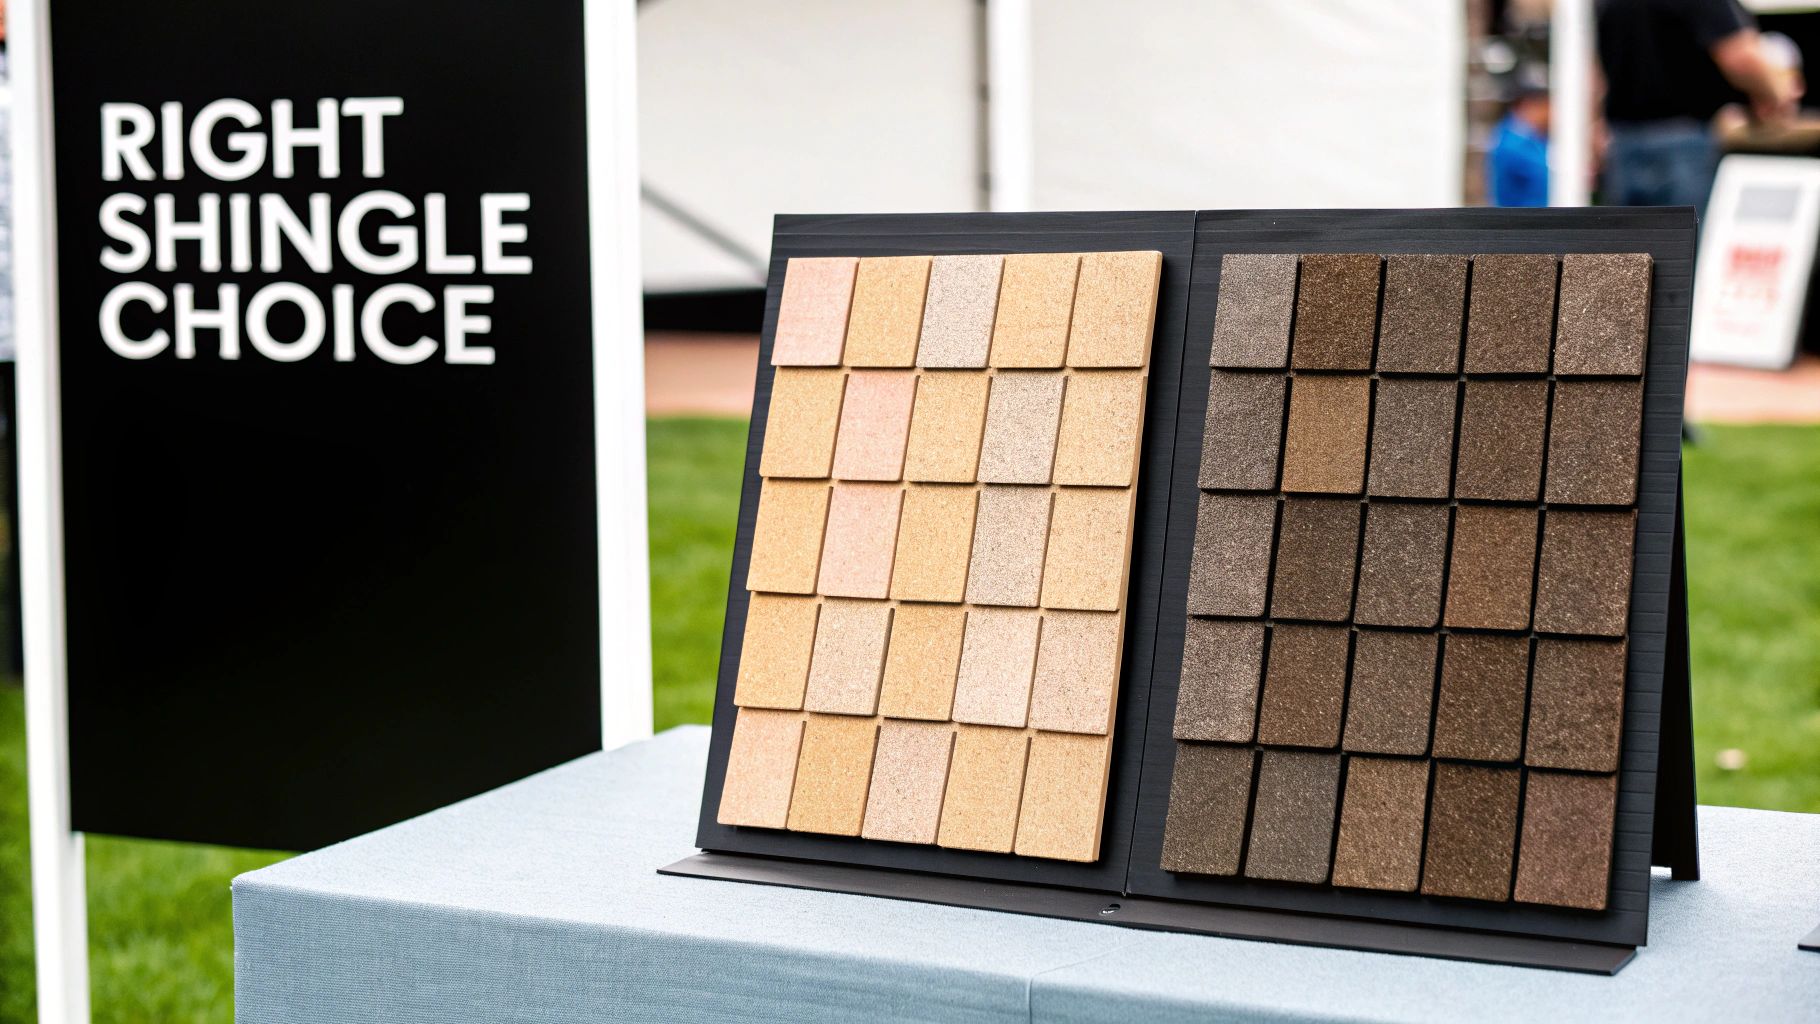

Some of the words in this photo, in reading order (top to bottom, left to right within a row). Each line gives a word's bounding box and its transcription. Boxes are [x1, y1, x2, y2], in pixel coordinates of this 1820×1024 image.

[100, 96, 404, 182] RIGHT
[98, 190, 533, 275] SHINGLE
[98, 281, 496, 365] CHOICE
